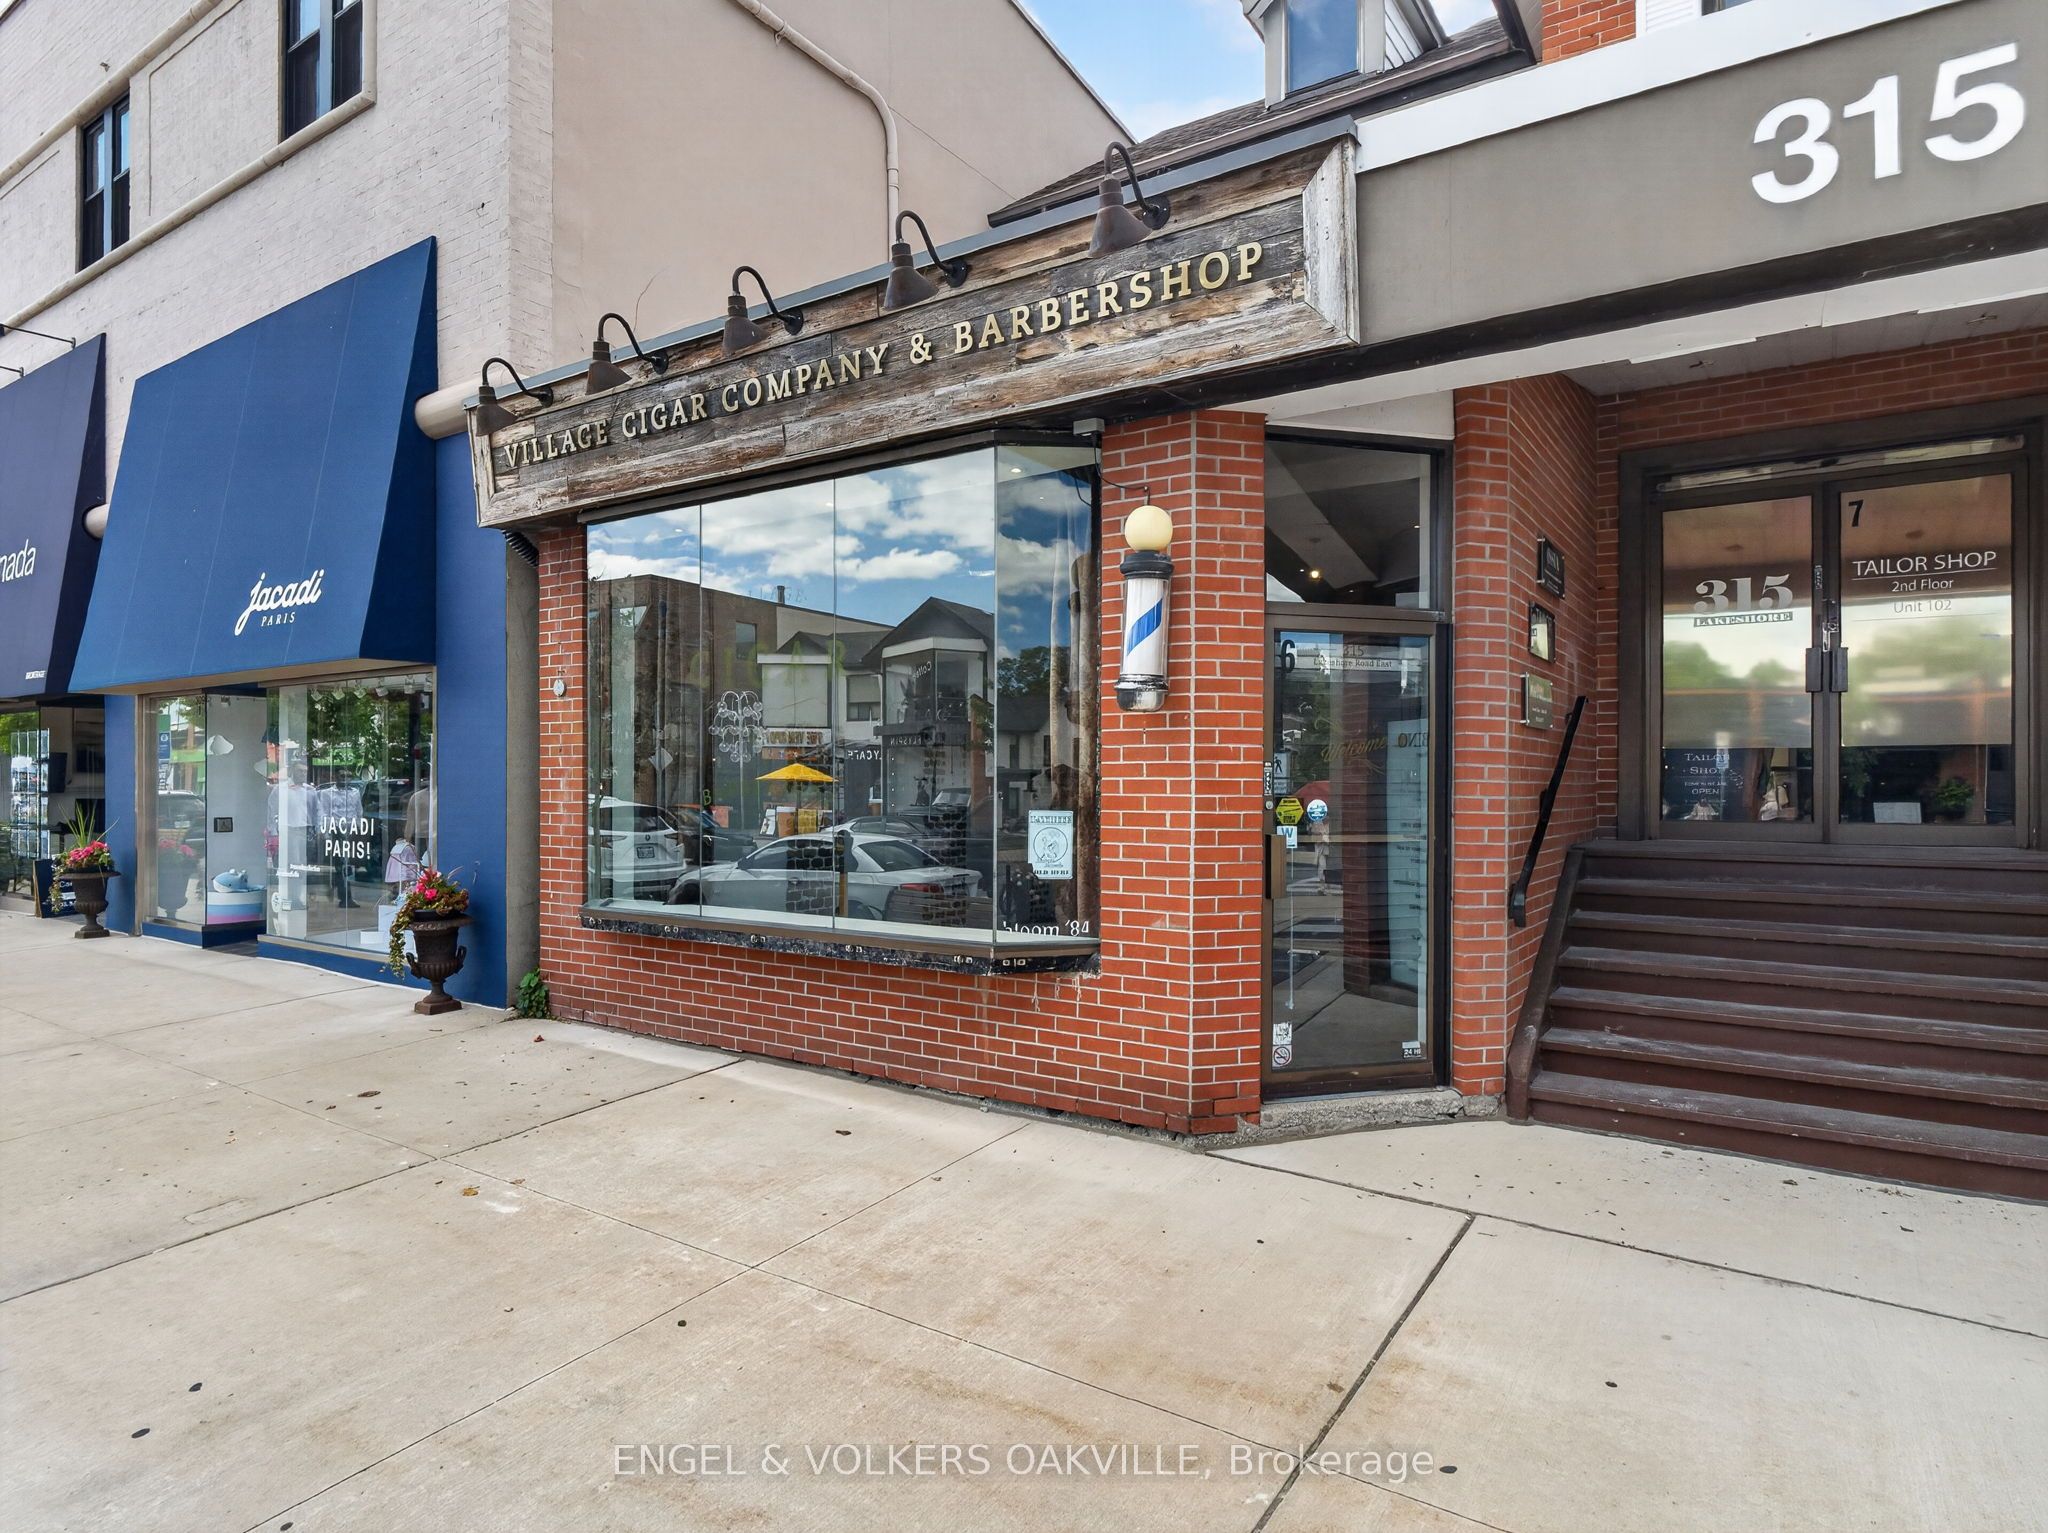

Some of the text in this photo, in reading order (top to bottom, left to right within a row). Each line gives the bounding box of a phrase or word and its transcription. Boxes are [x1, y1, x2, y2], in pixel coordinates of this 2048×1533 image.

[1751, 42, 2026, 204] 315
[504, 241, 1262, 469] VILLAGE CIGAR COMPANY & BARBERSHOP
[1848, 499, 1864, 527] 7
[1852, 551, 1997, 577] TAILOR SHOP
[1694, 574, 1793, 615] 315
[1892, 578, 1954, 592] 2nd Floor
[234, 569, 325, 636] jacadi
[1894, 600, 1952, 614] Unit 102
[261, 611, 296, 627] PARIS
[1694, 611, 1793, 627] LAKESHORE
[1281, 639, 1296, 673] 6
[1355, 658, 1375, 668] Road
[1376, 659, 1393, 668] East
[320, 816, 374, 836] JACADI
[325, 840, 371, 860] PARIS!
